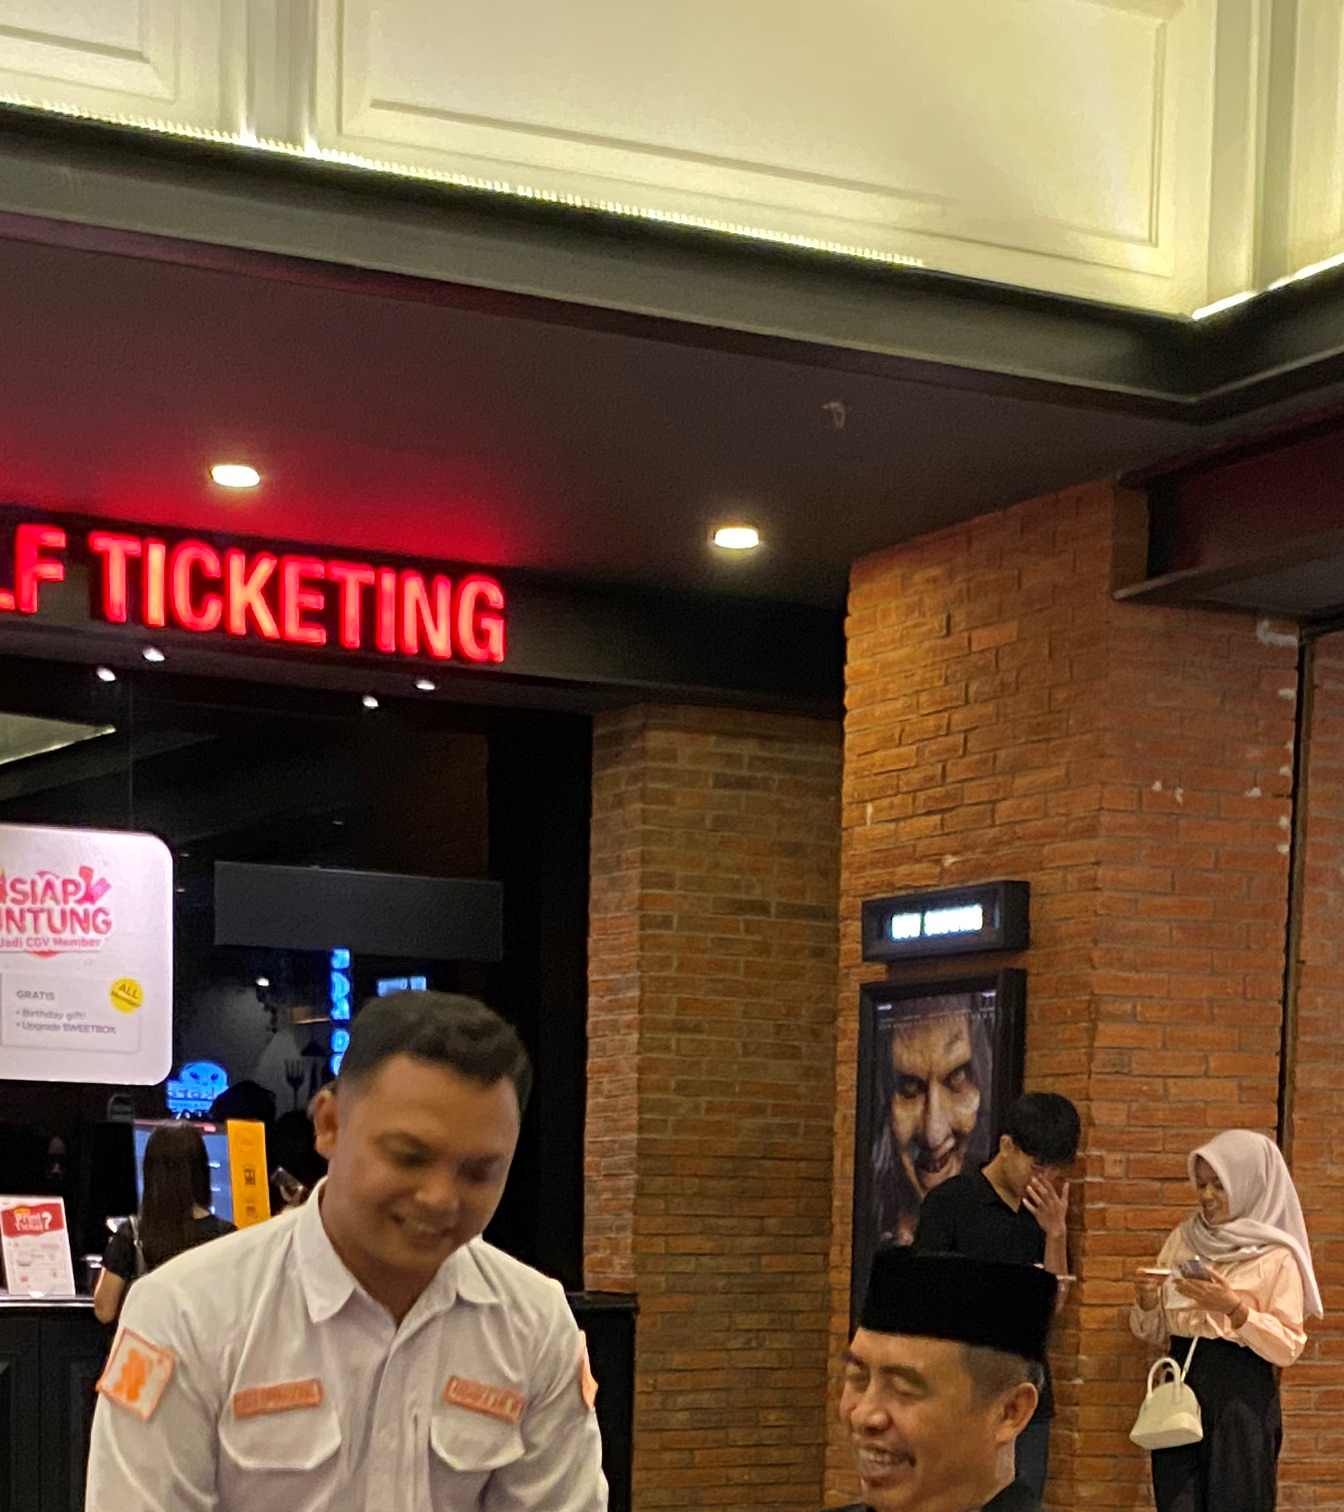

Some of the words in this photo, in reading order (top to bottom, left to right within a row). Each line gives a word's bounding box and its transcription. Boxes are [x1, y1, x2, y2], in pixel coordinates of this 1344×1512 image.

[88, 529, 506, 663] TICKETING
[9, 877, 81, 905] SIAP
[16, 990, 56, 1001] GRATIS
[119, 984, 139, 999] ALL
